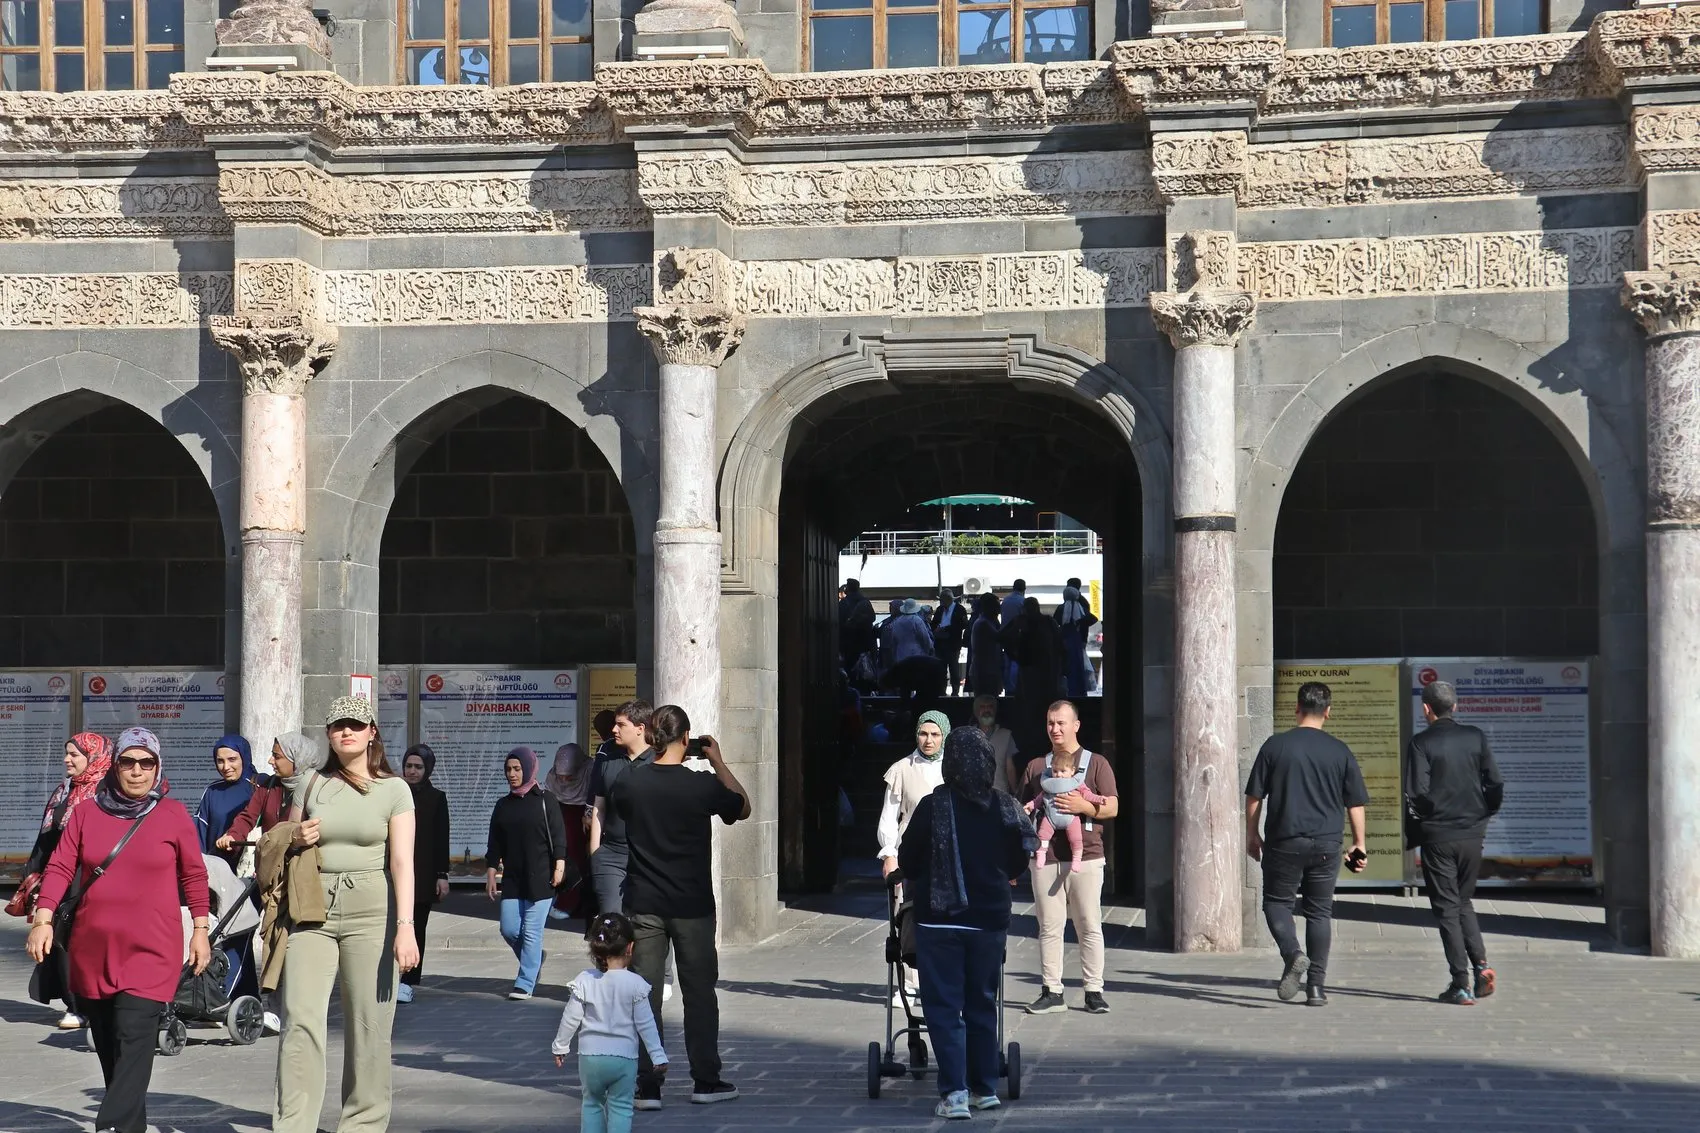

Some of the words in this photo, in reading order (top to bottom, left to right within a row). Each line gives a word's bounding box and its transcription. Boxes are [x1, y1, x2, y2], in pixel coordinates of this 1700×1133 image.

[1320, 669, 1350, 677] QURAN
[1474, 667, 1524, 675] DİYARBAKIR
[139, 675, 184, 684] DİYARBAKIR
[476, 674, 522, 682] DİYARBAKIR
[1474, 677, 1492, 686] İLÇE
[1493, 676, 1544, 685] MÜFTÜLÜĞÜ
[155, 684, 201, 693] MÜFTÜLÜĞÜ
[459, 684, 474, 692] SUR
[475, 683, 492, 693] İLÇE
[493, 683, 539, 692] MÜFTÜLÜĞÜ
[466, 702, 531, 713] DİYARBAKIR
[140, 711, 181, 719] DİYARBAKIR
